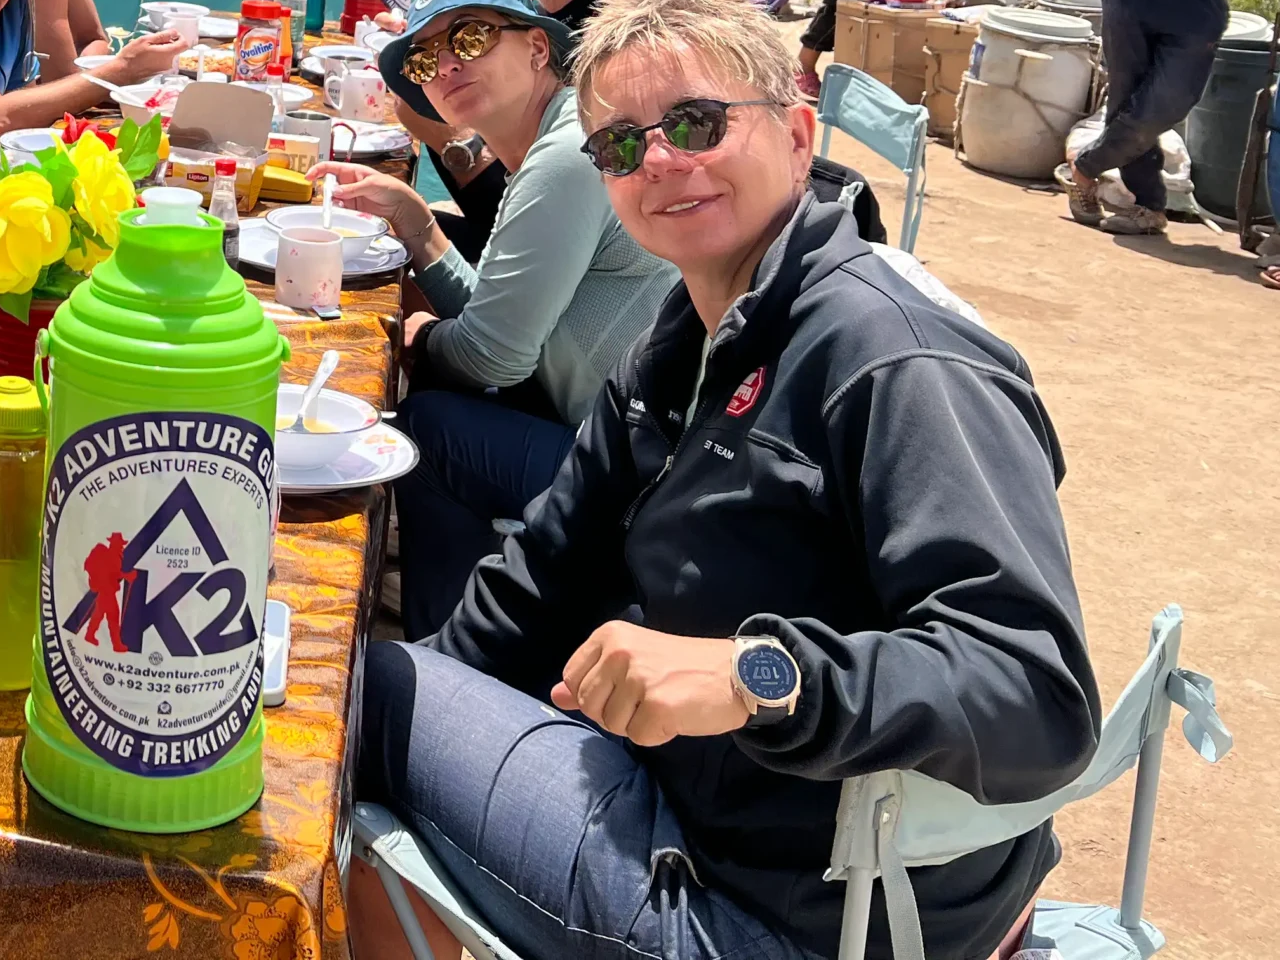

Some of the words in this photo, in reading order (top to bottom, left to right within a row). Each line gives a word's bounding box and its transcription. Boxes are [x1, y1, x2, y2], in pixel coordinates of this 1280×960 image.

[240, 42, 273, 59] Ovaltine
[289, 153, 318, 173] TEA
[713, 444, 734, 460] TEAM
[45, 476, 65, 525] K2
[63, 420, 258, 484] ADVENTURE
[79, 476, 106, 501] THE
[109, 458, 218, 485] ADVENTURES
[221, 467, 264, 509] EXPERTS
[155, 544, 189, 556] Licence
[191, 546, 201, 556] ID
[166, 558, 189, 569] 2523
[122, 567, 258, 658] K2
[41, 562, 135, 758] MOUNTAINEERING
[141, 712, 242, 765] TREKKING
[241, 666, 263, 717] AND
[84, 653, 241, 680] www.k2adventure.com.pk
[66, 639, 150, 726] info@k2adventure.com.pk
[117, 677, 143, 690] +92
[147, 682, 171, 694] 332
[175, 678, 225, 694] 6677770
[157, 650, 254, 729] k2adventureguide@gmail.com
